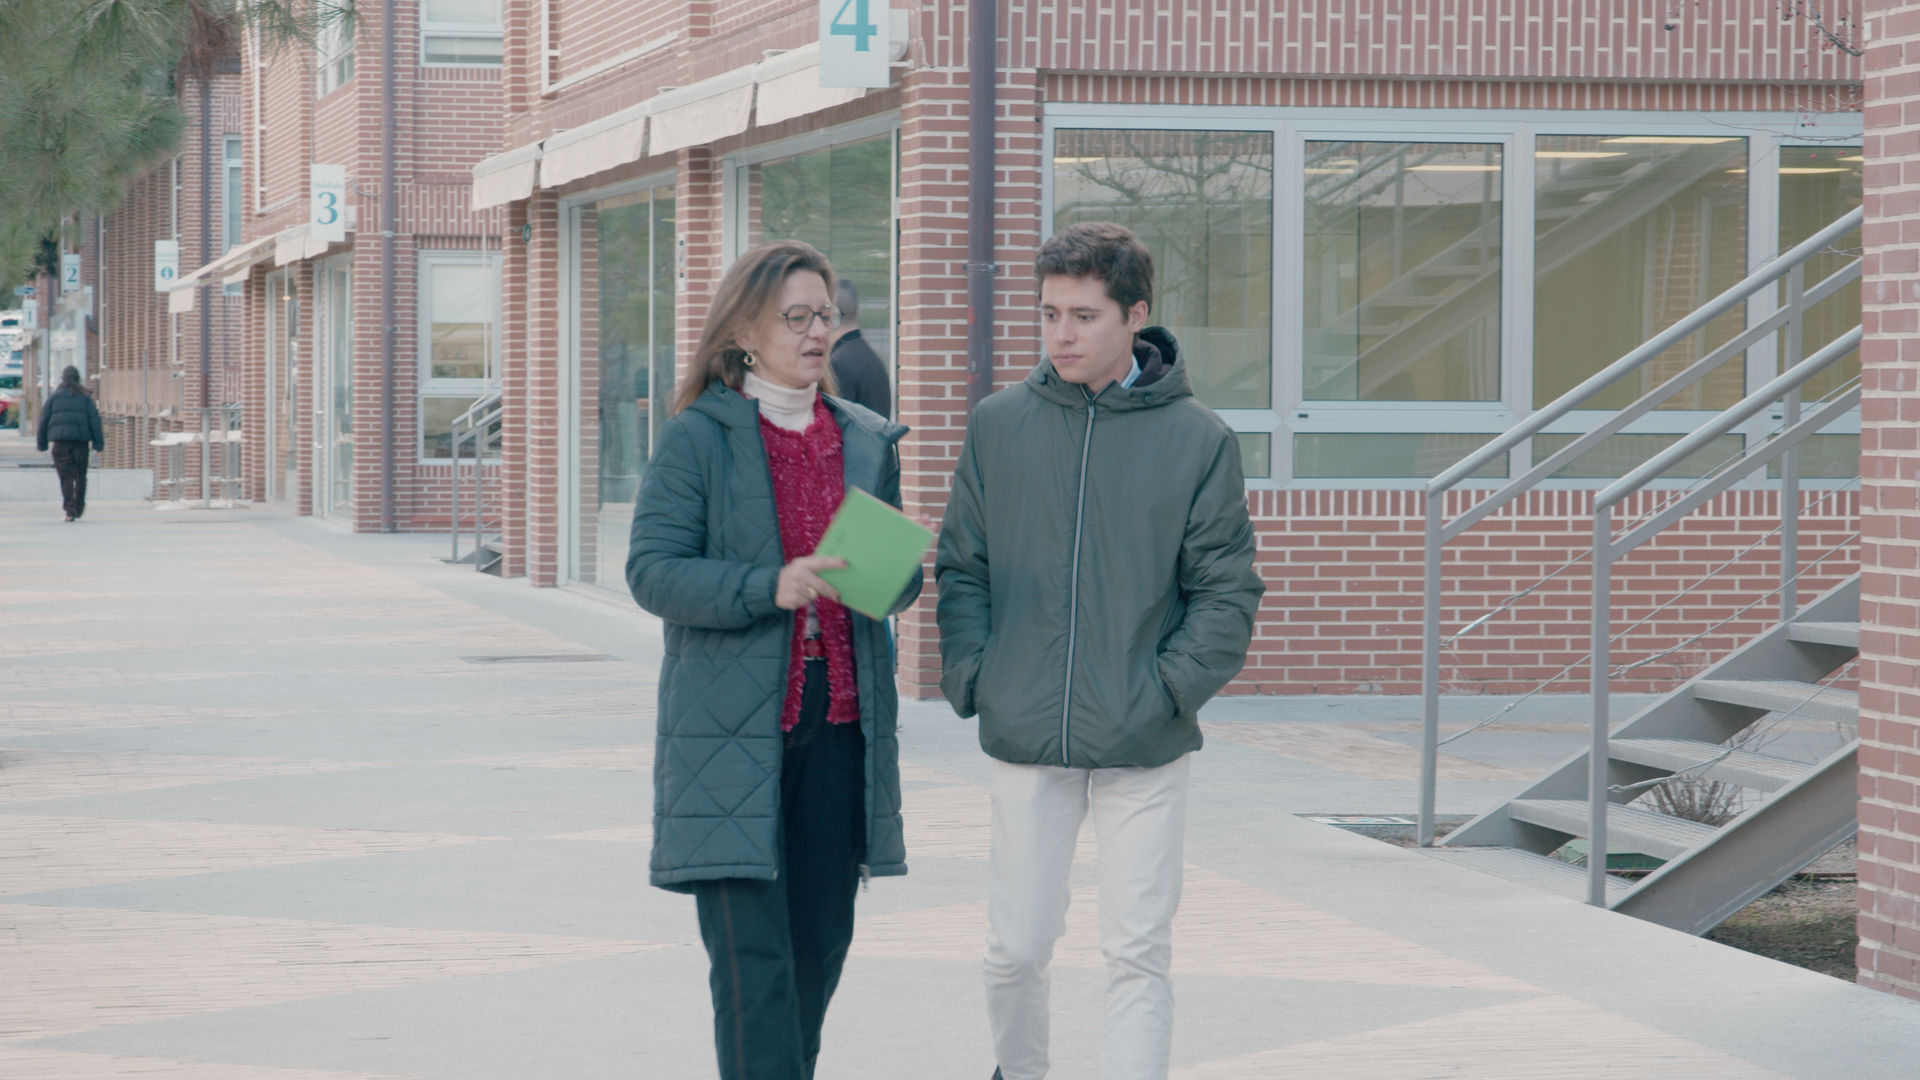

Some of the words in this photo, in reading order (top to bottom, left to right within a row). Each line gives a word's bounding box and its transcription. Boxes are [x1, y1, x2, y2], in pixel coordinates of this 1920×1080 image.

[830, 0, 877, 52] 4
[317, 192, 338, 225] 3
[66, 267, 77, 283] 2
[26, 310, 33, 323] 1
